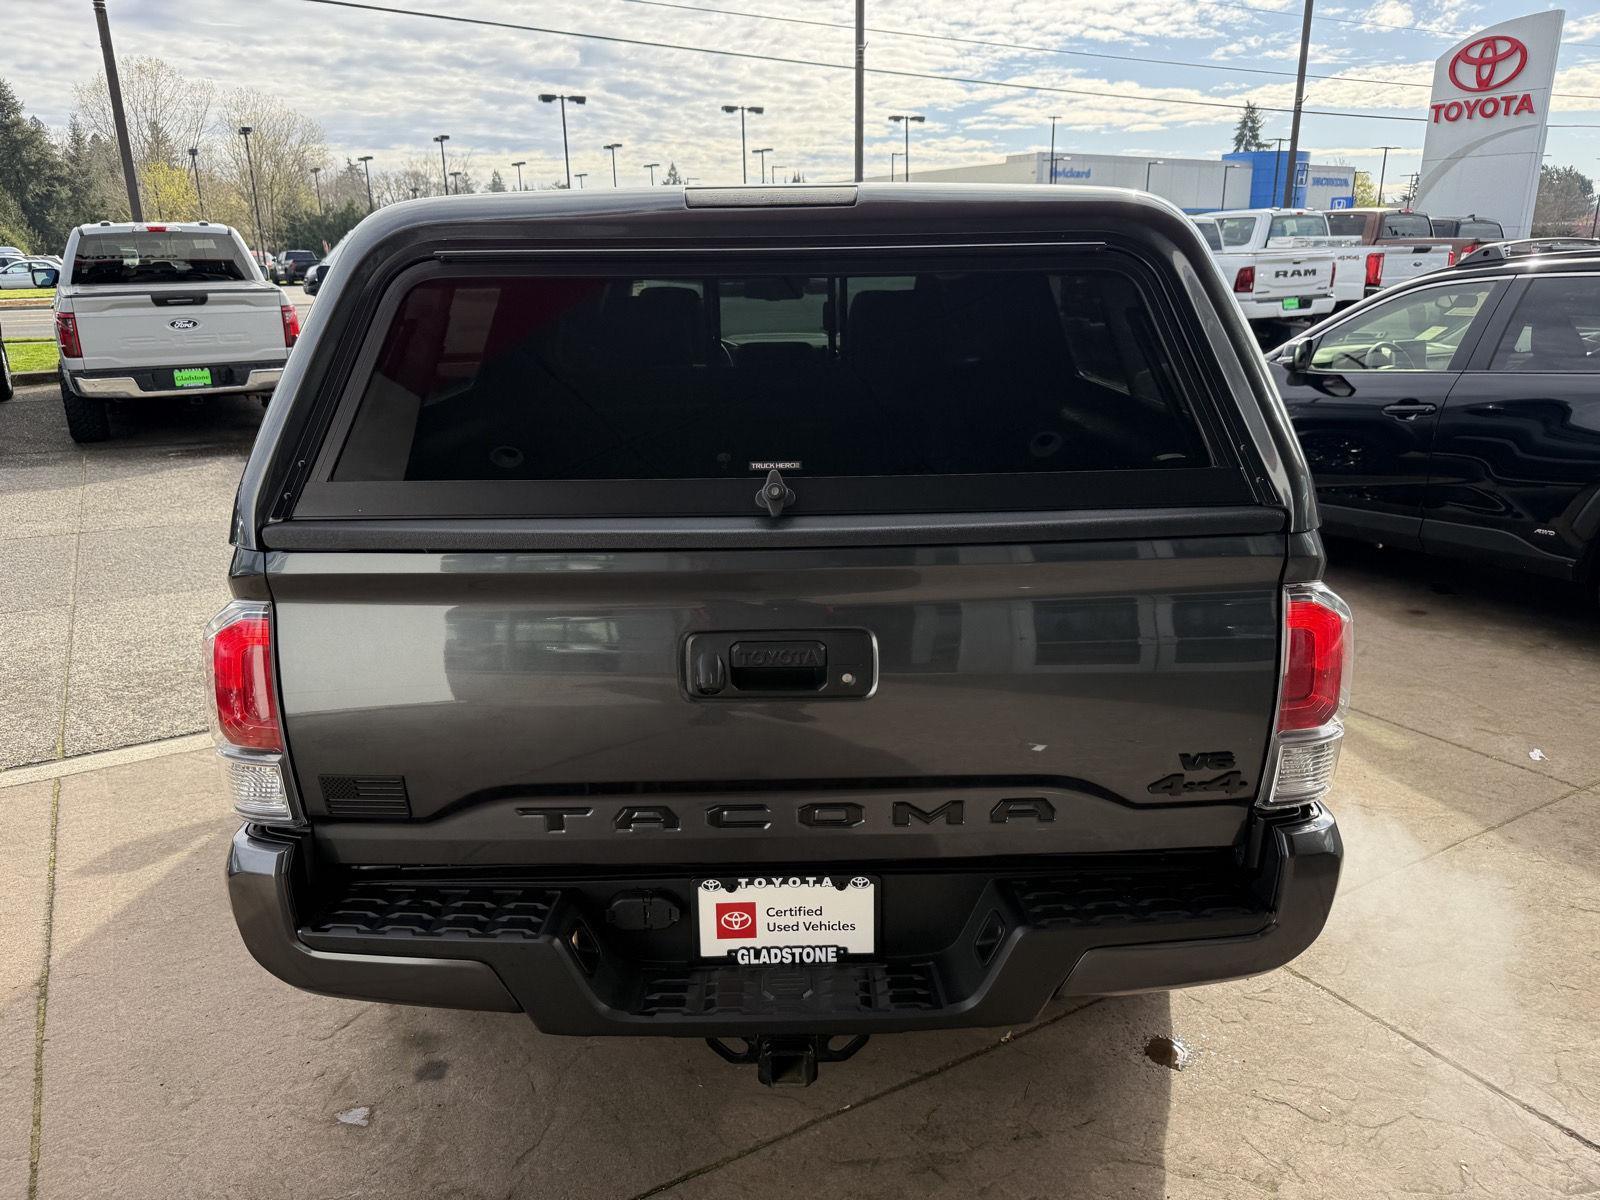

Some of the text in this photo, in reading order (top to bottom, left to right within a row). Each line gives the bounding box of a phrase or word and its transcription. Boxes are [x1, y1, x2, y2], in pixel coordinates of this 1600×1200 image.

[1431, 94, 1535, 123] TOYOTA
[1275, 269, 1317, 278] RAM
[174, 320, 194, 329] Ford
[1534, 528, 1556, 536] AWD
[738, 649, 820, 665] TOYOTA
[1179, 751, 1235, 771] V6
[515, 797, 1057, 833] TACOMA
[737, 876, 833, 889] TOYOTA
[766, 905, 823, 917] Certified
[767, 921, 856, 932] Used Vehicles
[737, 947, 838, 964] GLADSTONE
